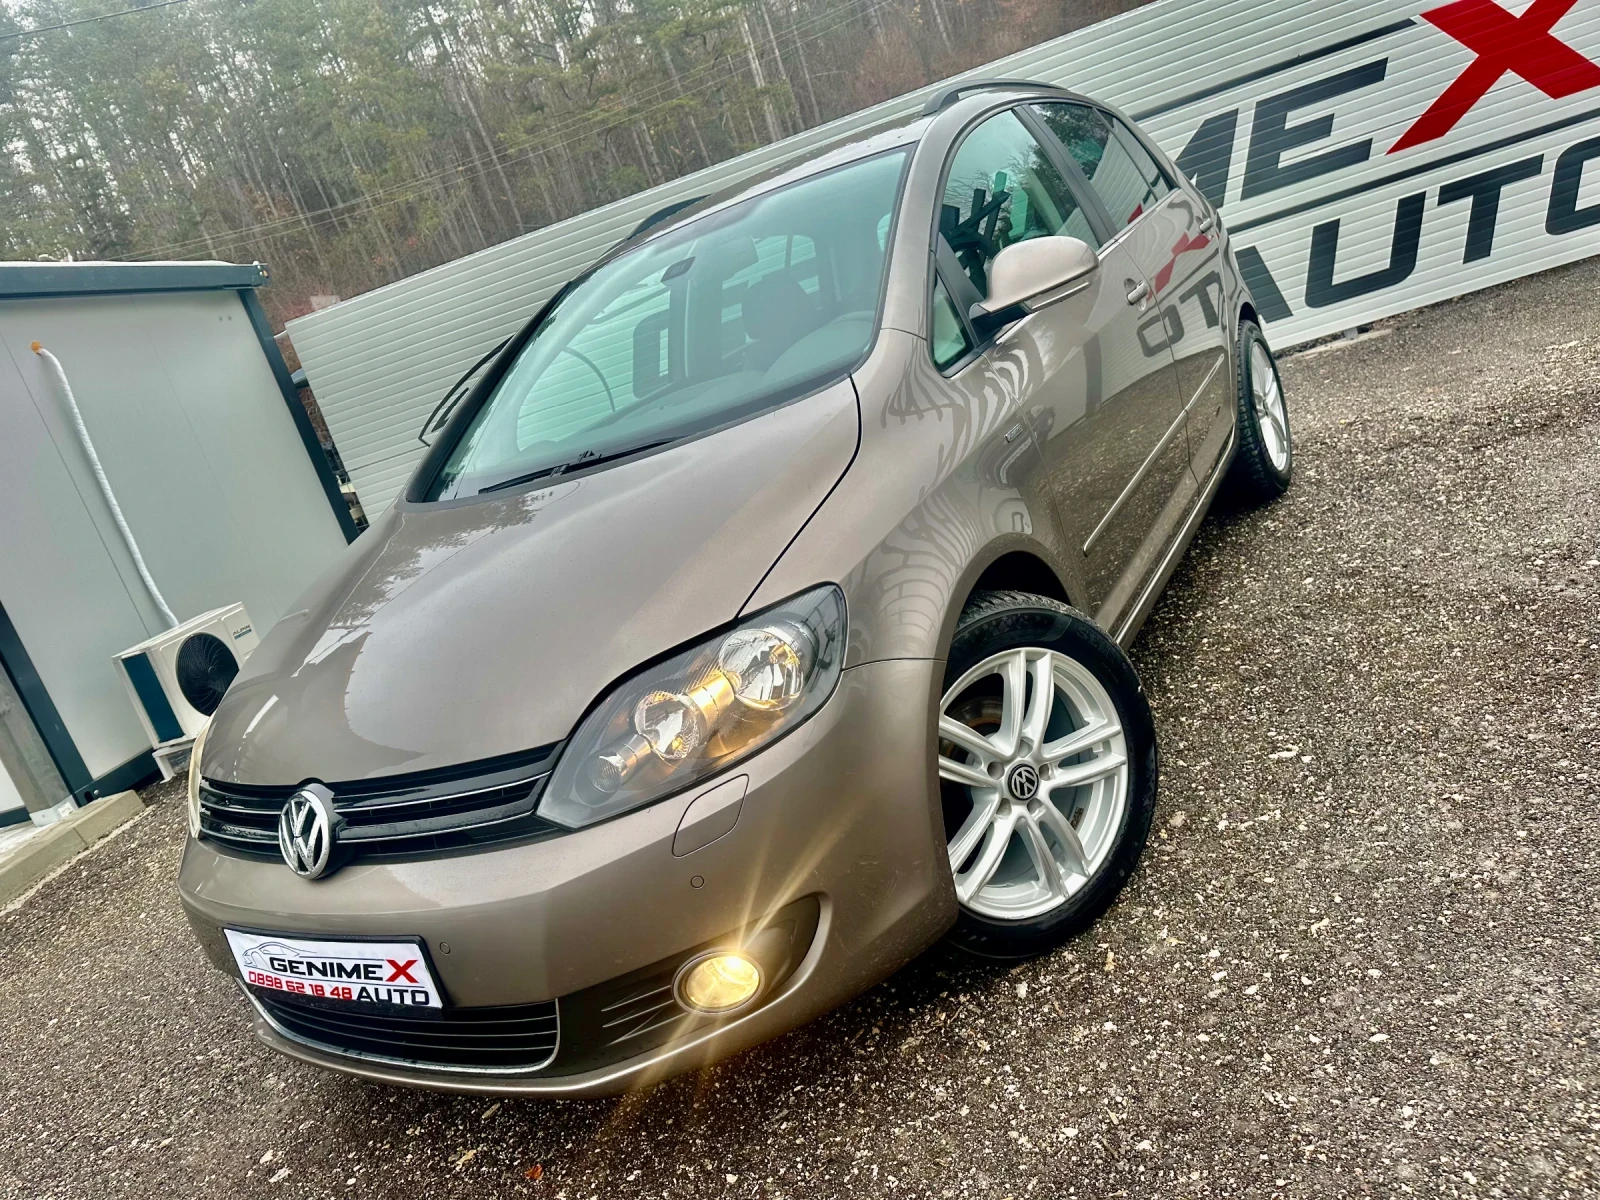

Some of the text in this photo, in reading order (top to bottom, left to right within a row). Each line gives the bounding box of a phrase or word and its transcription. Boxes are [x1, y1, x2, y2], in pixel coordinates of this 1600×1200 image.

[269, 957, 419, 983] GENIMEX
[248, 971, 352, 1001] 0898 62 18 48
[356, 986, 429, 1006] AUTO
